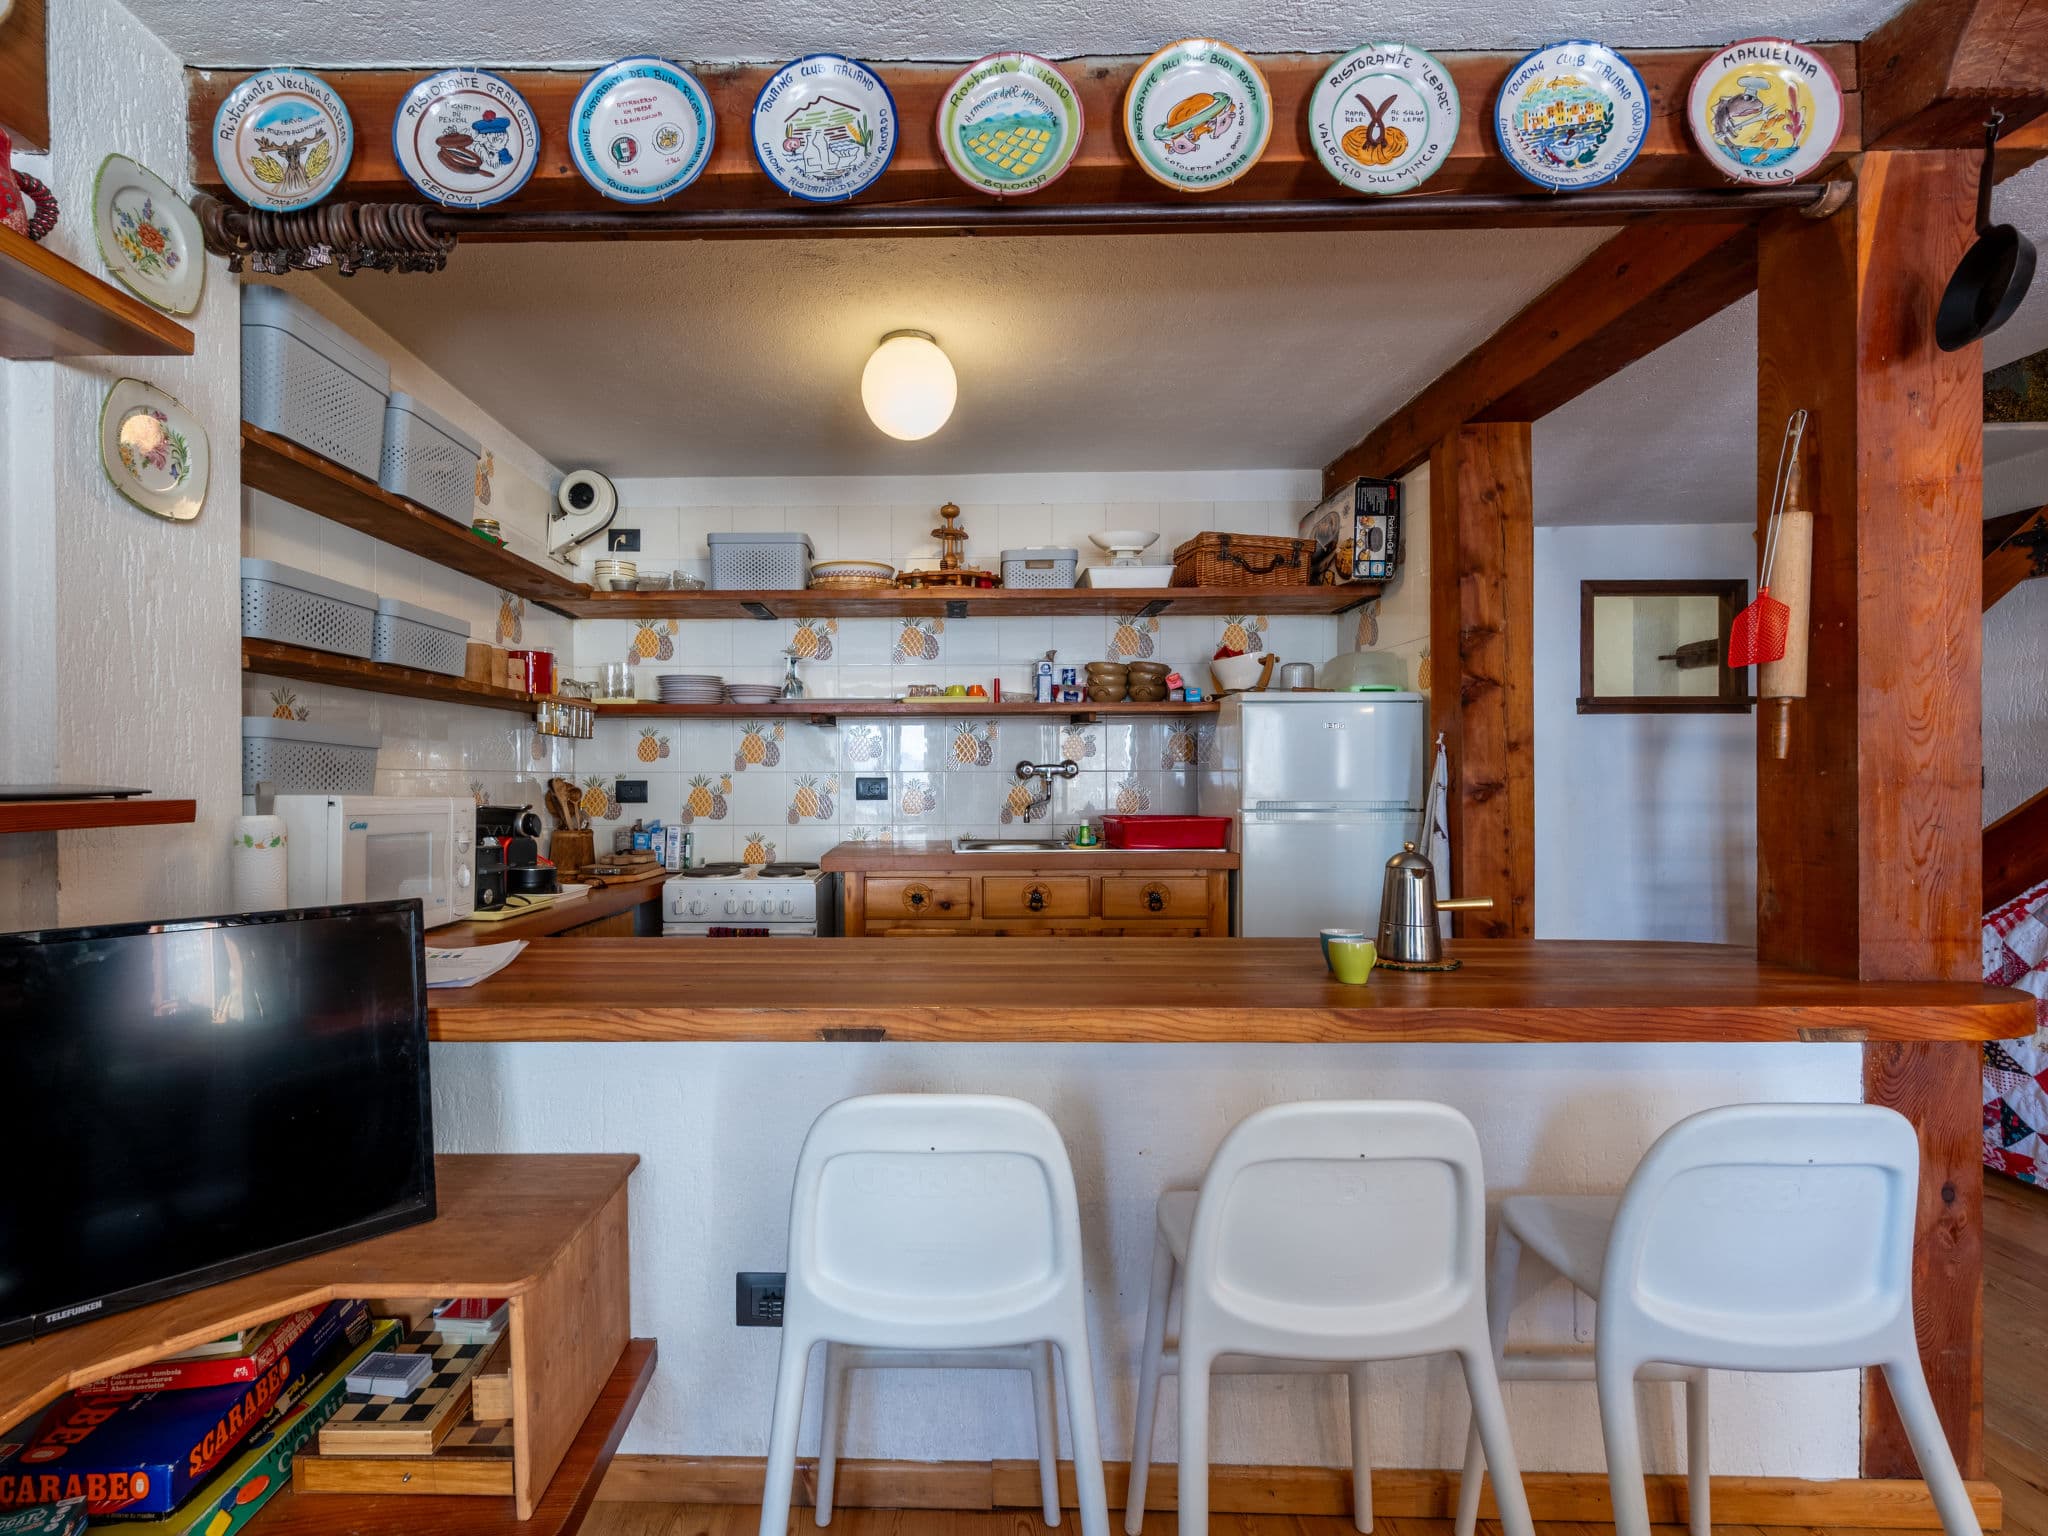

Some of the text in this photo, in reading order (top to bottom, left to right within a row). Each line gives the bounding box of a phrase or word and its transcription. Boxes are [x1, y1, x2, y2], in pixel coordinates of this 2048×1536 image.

[629, 70, 649, 79] DEL
[653, 70, 679, 88] BUON
[1329, 53, 1414, 89] RISTORANTE
[1723, 47, 1818, 79] MANUELINA
[760, 63, 875, 113] TOURING CLUB ITALIANO
[1507, 60, 1545, 97] TOURING
[1592, 60, 1632, 101] ITALIANO
[220, 79, 274, 141] Ristorante
[276, 75, 322, 99] Vecchia
[406, 77, 535, 148] RISTORANTE GRAN GOTTO
[582, 75, 624, 120] RISTORANTI
[682, 85, 703, 126] RICORDO
[1134, 72, 1158, 141] RISTORANTE
[1209, 54, 1233, 71] BUOI
[582, 129, 596, 162] UNIONE
[762, 142, 786, 176] UNIONE
[788, 176, 838, 194] RISTORANTI
[839, 179, 860, 191] DEL
[858, 156, 882, 182] BUON
[878, 108, 889, 154] RICORDO
[1318, 123, 1439, 184] VALEGGIO SUL MINCIO
[1604, 148, 1629, 170] BUON
[983, 174, 1047, 190] BOLOGNA
[1172, 153, 1248, 183] ALESSANDRIA
[1744, 168, 1794, 180] RECCO
[420, 178, 473, 203] GENOVA
[606, 177, 647, 195] TOURING
[45, 1299, 102, 1323] TELEFUNKEN
[189, 1355, 290, 1478] SCARABEO
[0, 1471, 150, 1503] CARABEO
